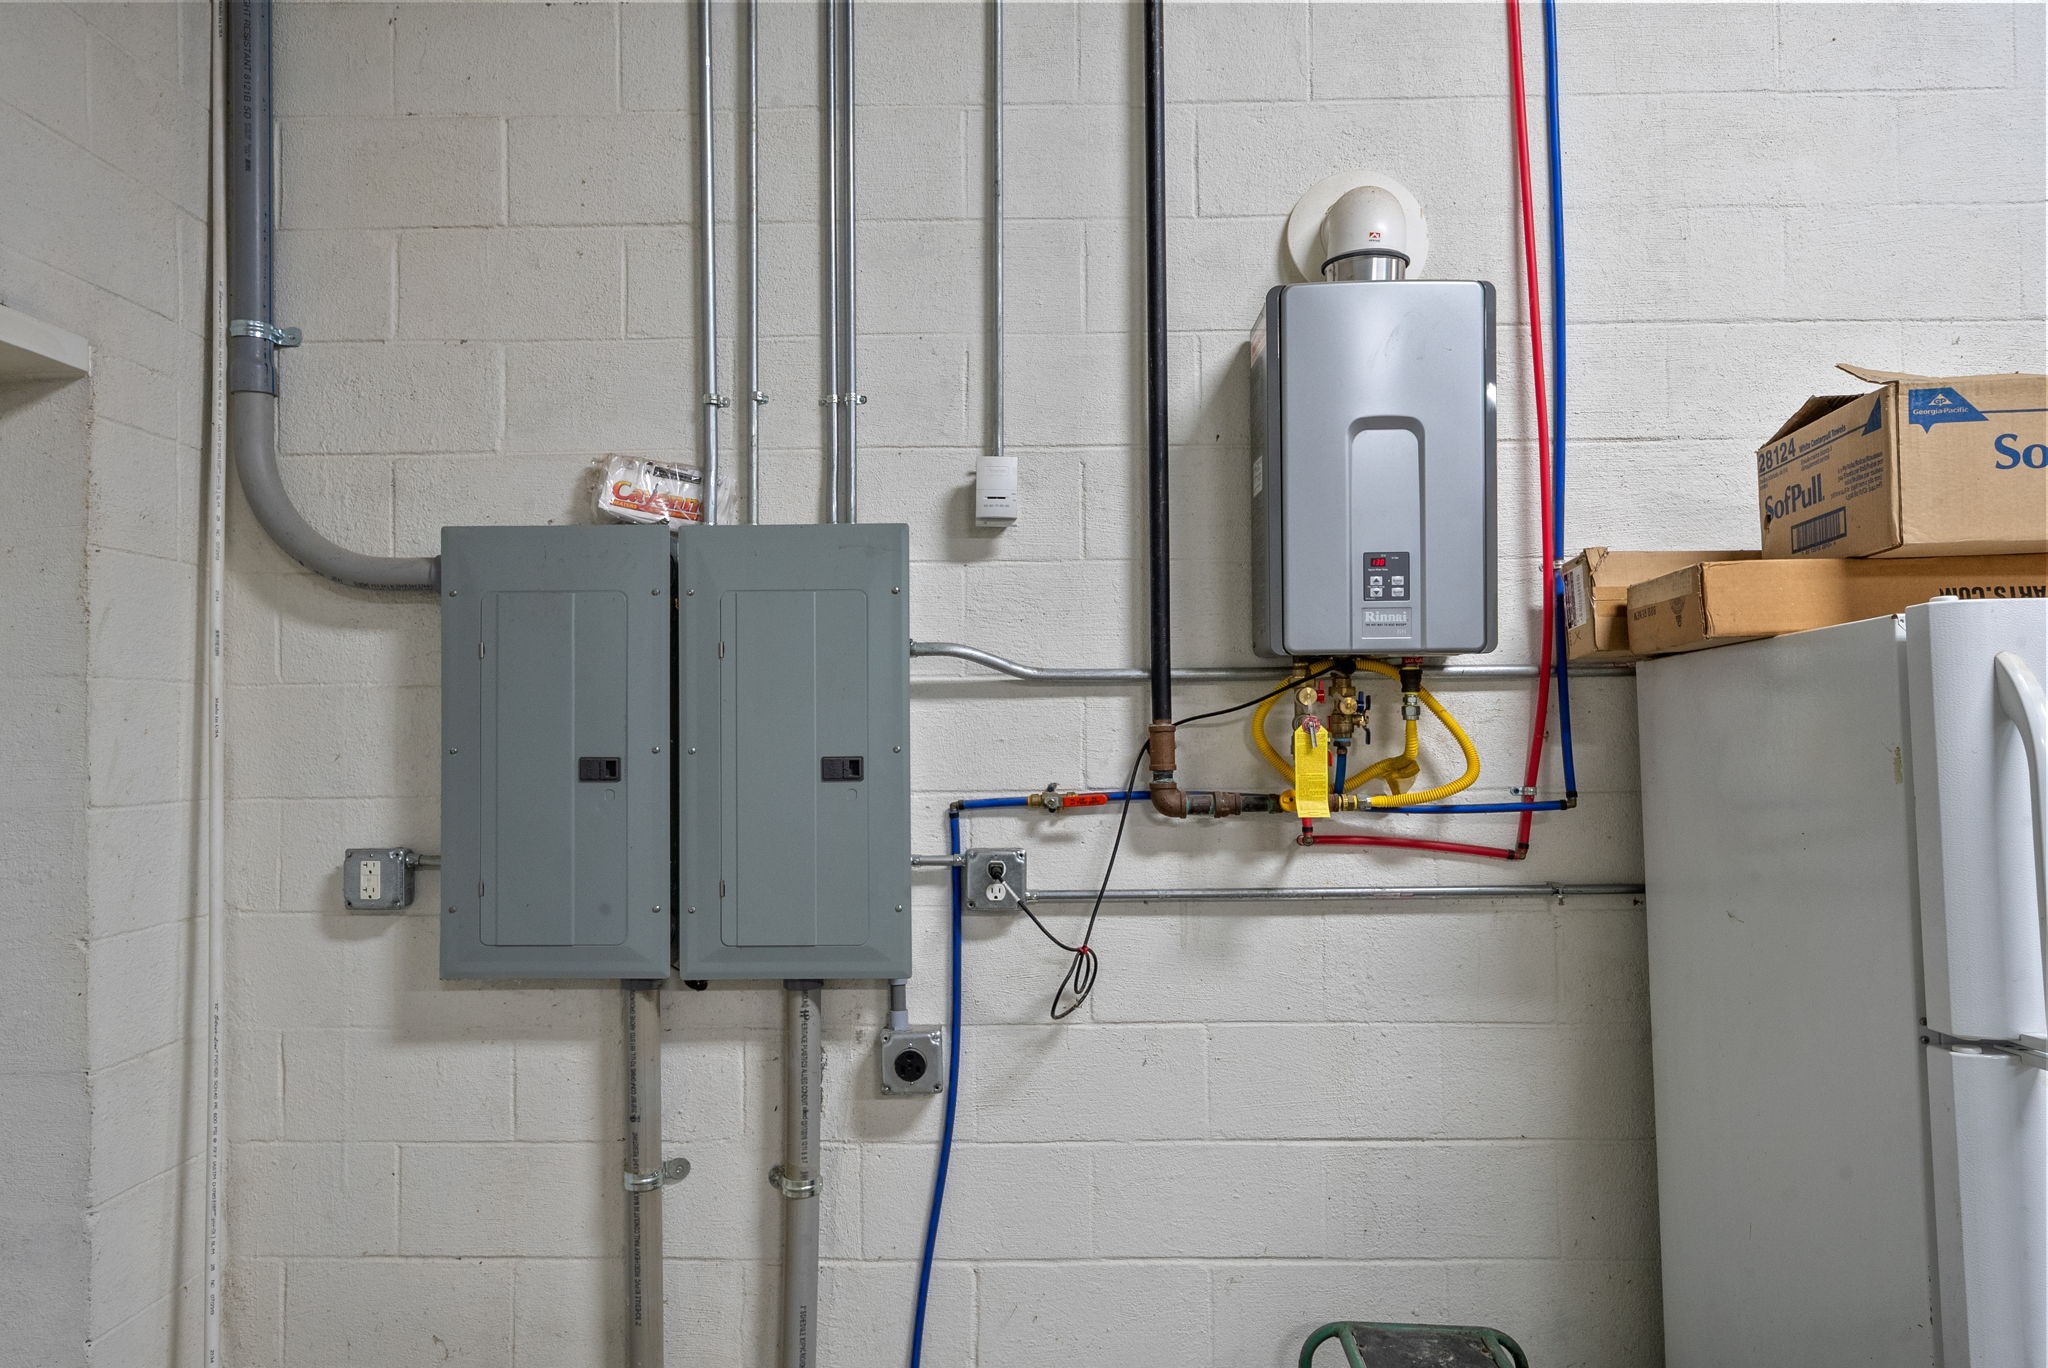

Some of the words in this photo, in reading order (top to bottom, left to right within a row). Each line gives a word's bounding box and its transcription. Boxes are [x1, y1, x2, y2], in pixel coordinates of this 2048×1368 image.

[243, 19, 252, 72] RESISTANT
[1758, 437, 1796, 472] 28124
[1765, 473, 1823, 521] SofPull
[1364, 610, 1407, 622] Rinnai
